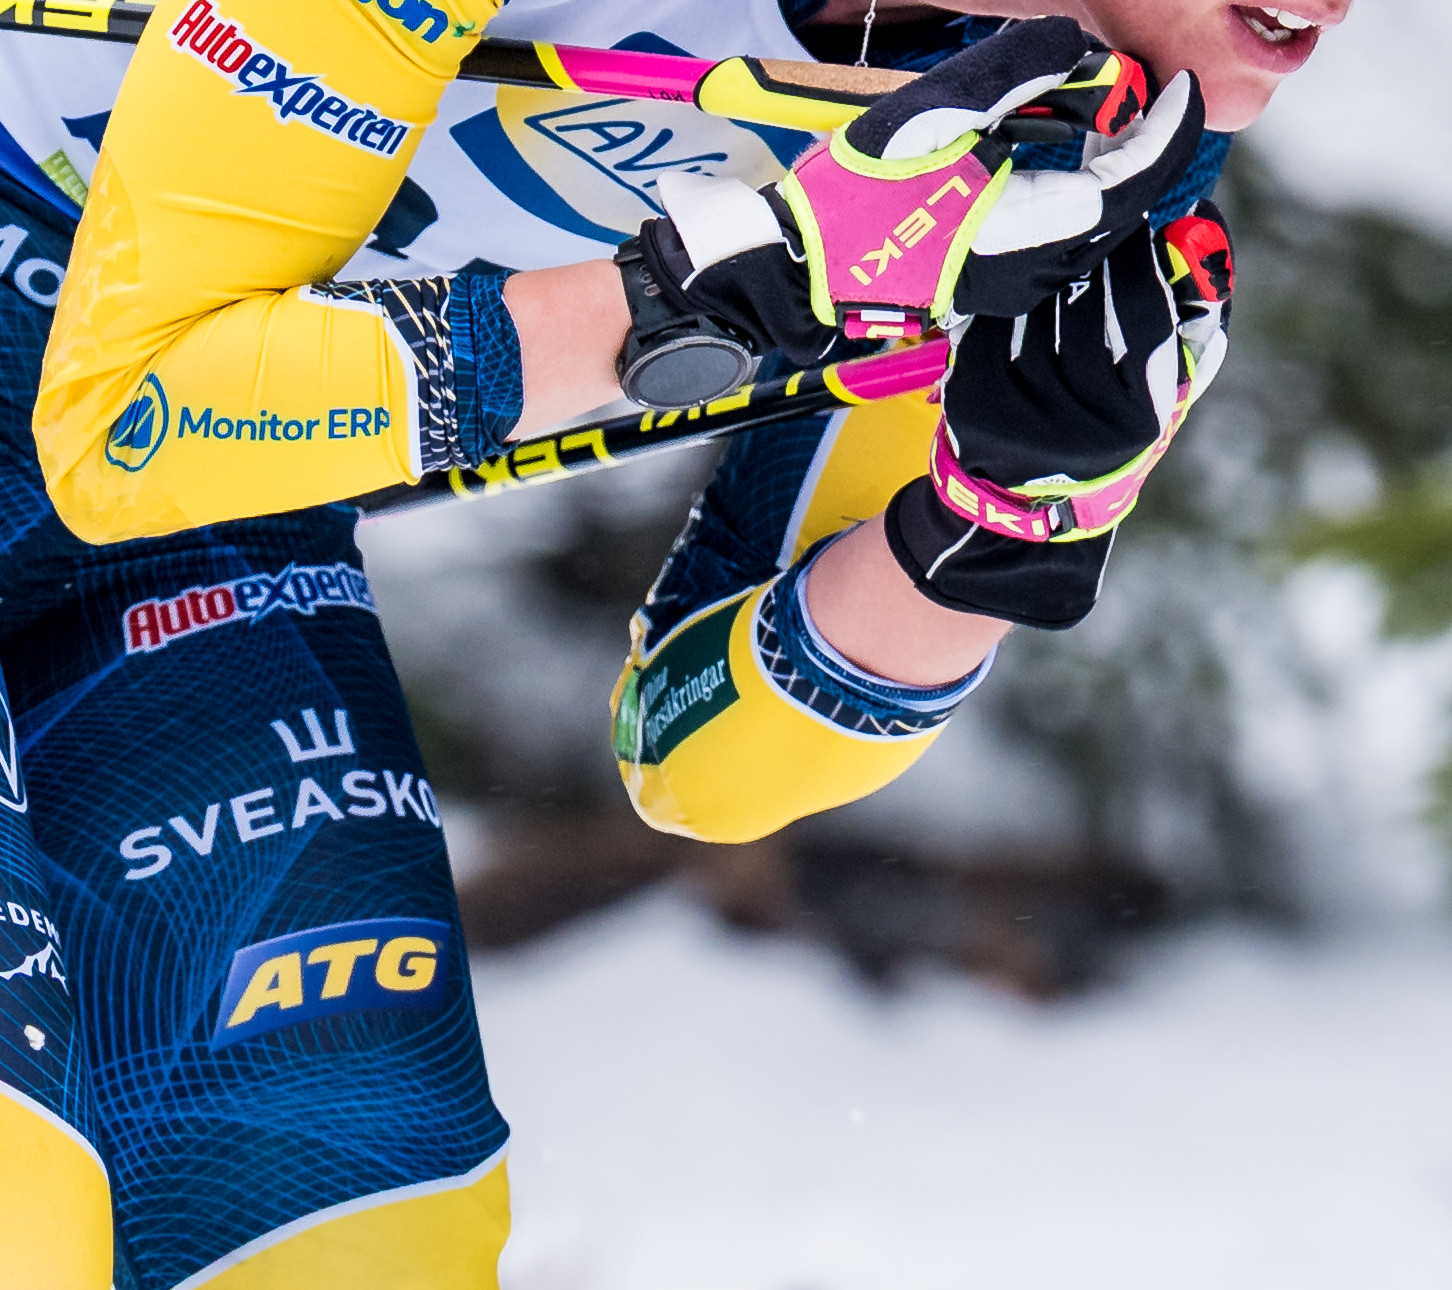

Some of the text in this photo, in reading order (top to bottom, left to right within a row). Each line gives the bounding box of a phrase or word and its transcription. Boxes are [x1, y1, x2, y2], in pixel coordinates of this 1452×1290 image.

[848, 175, 972, 286] LEKI
[177, 406, 390, 442] Monitor ERP
[119, 769, 441, 881] SVEASKO
[226, 937, 440, 1028] ATG
